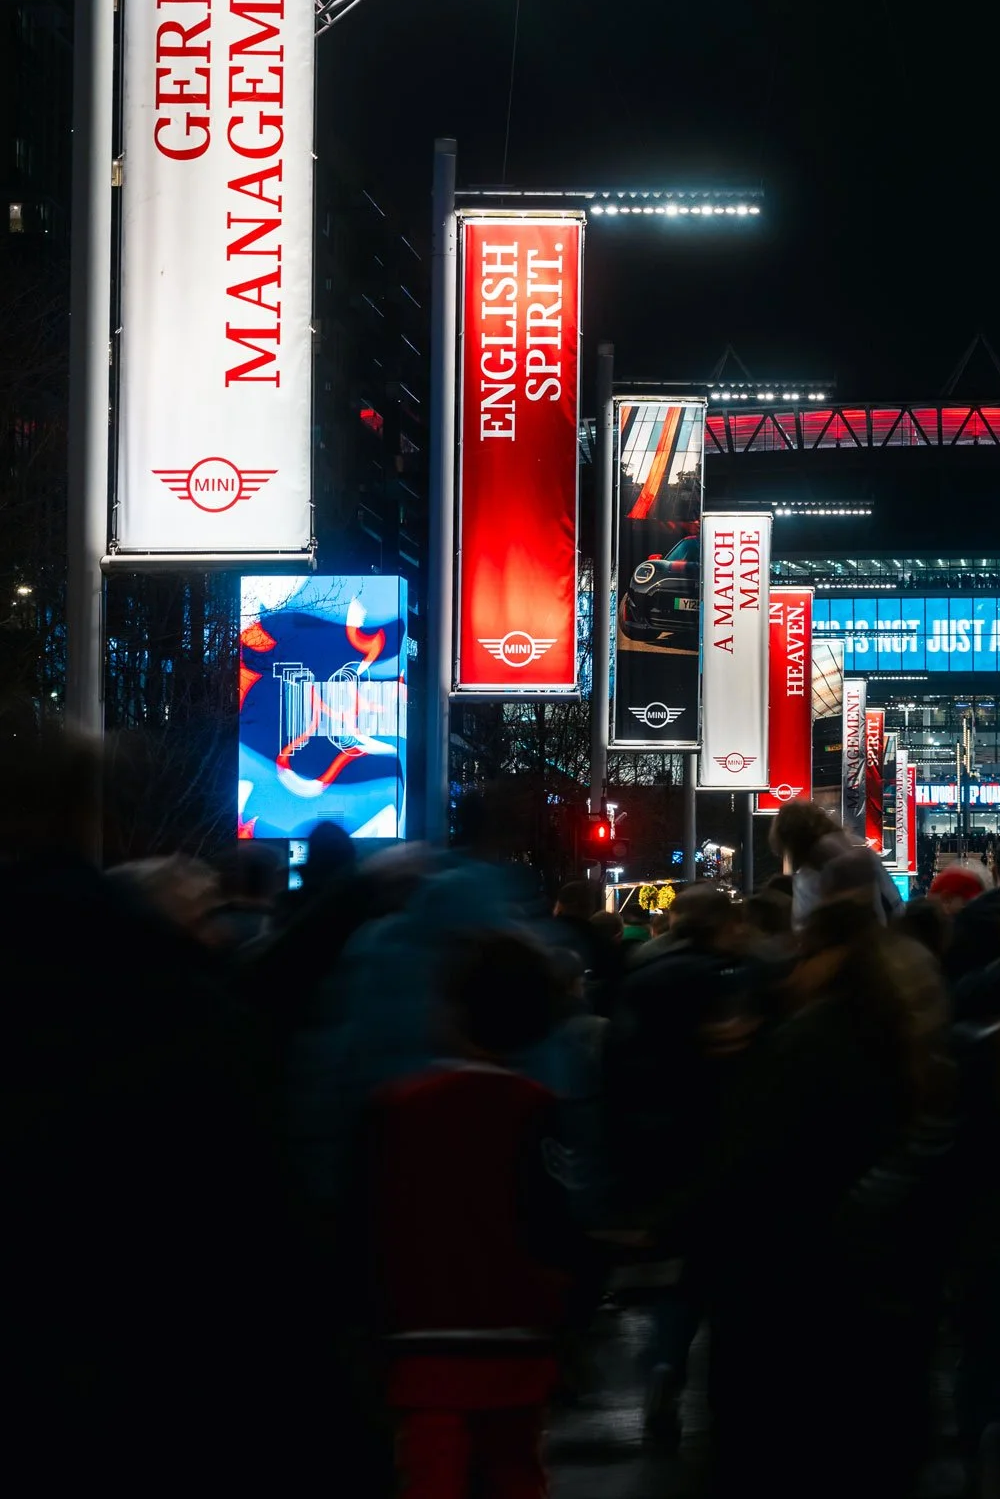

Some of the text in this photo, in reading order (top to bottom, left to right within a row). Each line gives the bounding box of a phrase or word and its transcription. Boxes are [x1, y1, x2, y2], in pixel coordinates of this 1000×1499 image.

[479, 240, 520, 442] ENGLISH
[525, 242, 564, 402] SPIRIT.
[195, 476, 236, 493] MINI
[713, 531, 735, 654] A MATCH
[739, 530, 761, 611] MADE
[505, 644, 531, 654] MINI
[769, 602, 784, 625] IN
[786, 601, 805, 697] HEAVEN.
[872, 619, 921, 653] NOT
[927, 619, 985, 653] JUST
[647, 711, 667, 719] MINI
[847, 689, 860, 809] MANAGEMENT.
